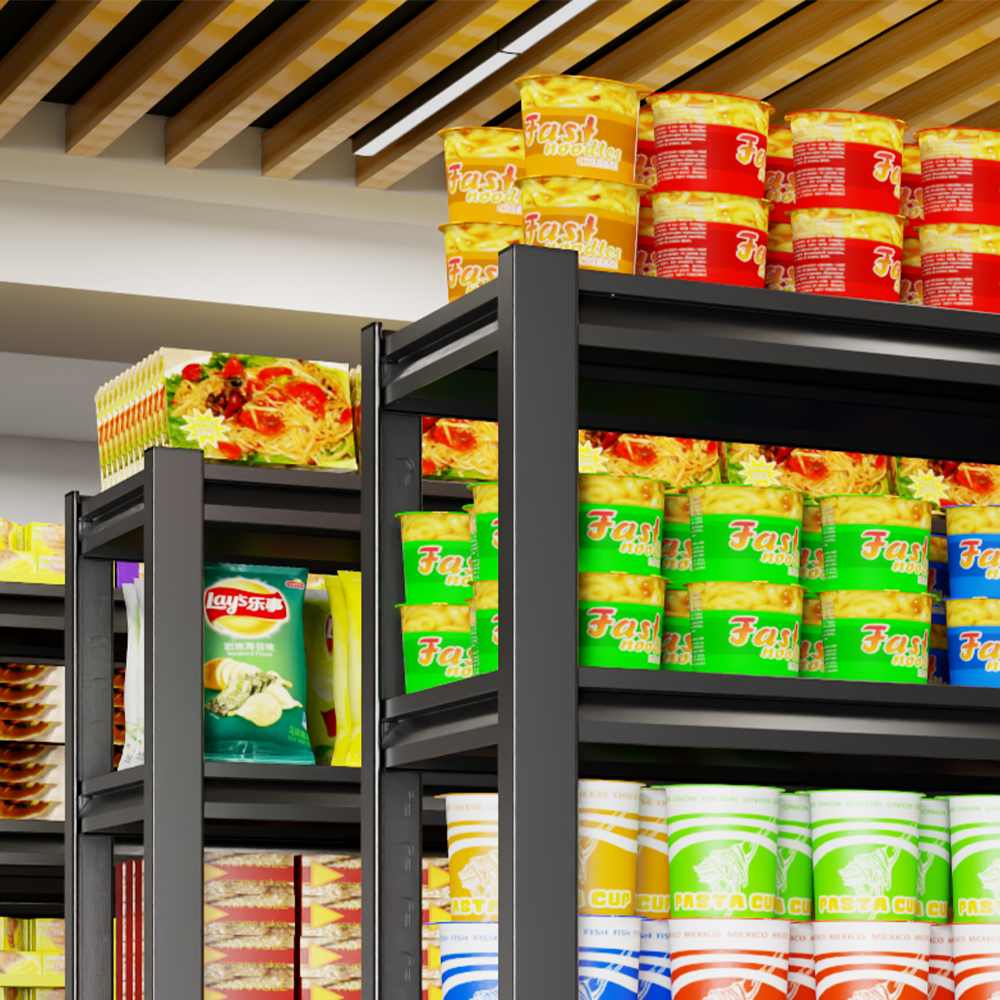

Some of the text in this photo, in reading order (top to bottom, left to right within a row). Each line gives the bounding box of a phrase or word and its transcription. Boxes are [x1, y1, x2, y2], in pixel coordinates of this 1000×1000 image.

[525, 113, 598, 146] Fast
[544, 139, 622, 161] noodles
[448, 162, 517, 194] Fast
[525, 212, 598, 244] Fast
[206, 590, 248, 615] Lay's
[591, 889, 632, 909] CUP
[674, 892, 750, 911] PASTA
[819, 895, 892, 914] PASTA
